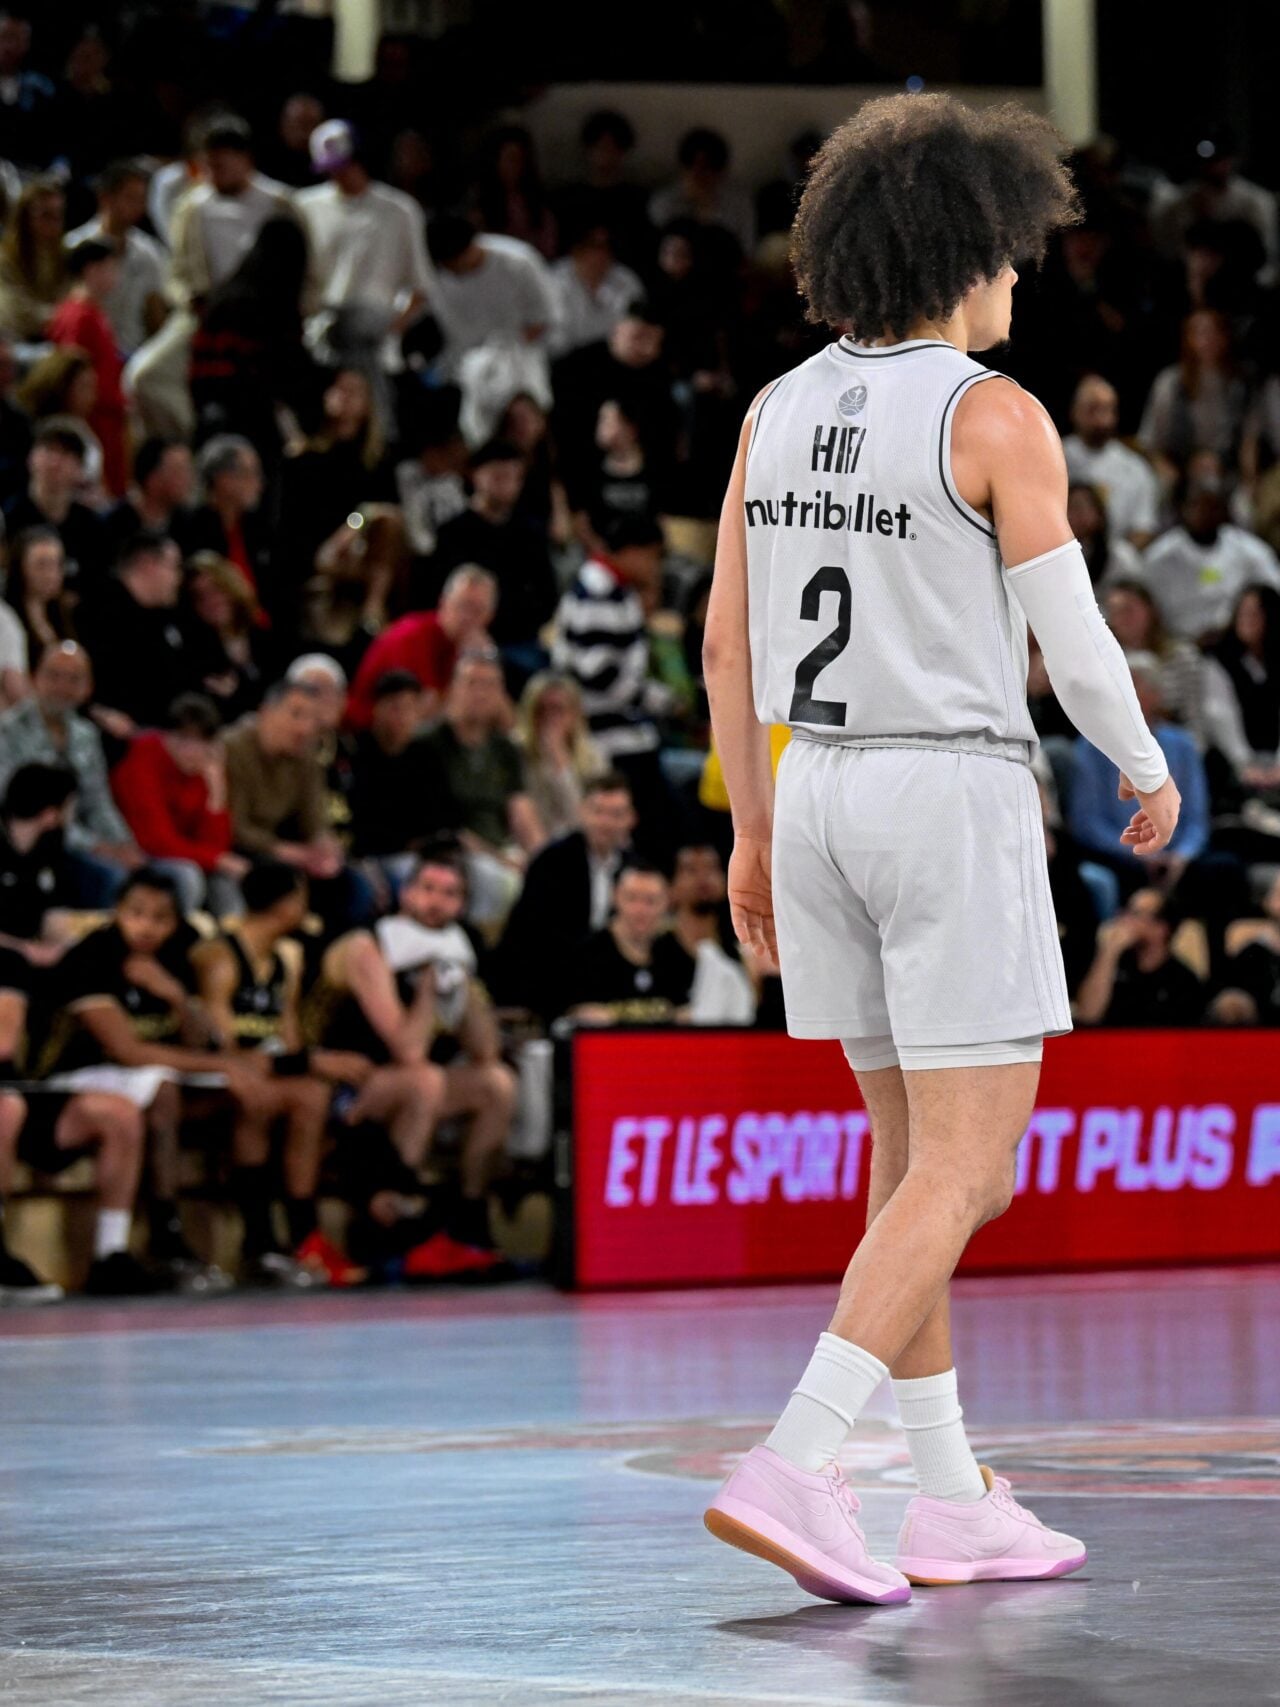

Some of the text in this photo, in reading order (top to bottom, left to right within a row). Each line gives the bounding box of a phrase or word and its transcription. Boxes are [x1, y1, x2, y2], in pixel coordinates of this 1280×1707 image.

[811, 425, 867, 474] HIFI
[744, 489, 912, 540] nutribllet
[789, 566, 852, 727] 2
[604, 1114, 673, 1208] ET
[671, 1113, 727, 1206] LE
[726, 1111, 870, 1205] SPORT
[1015, 1106, 1077, 1195] IT
[1074, 1104, 1236, 1193] PLUS
